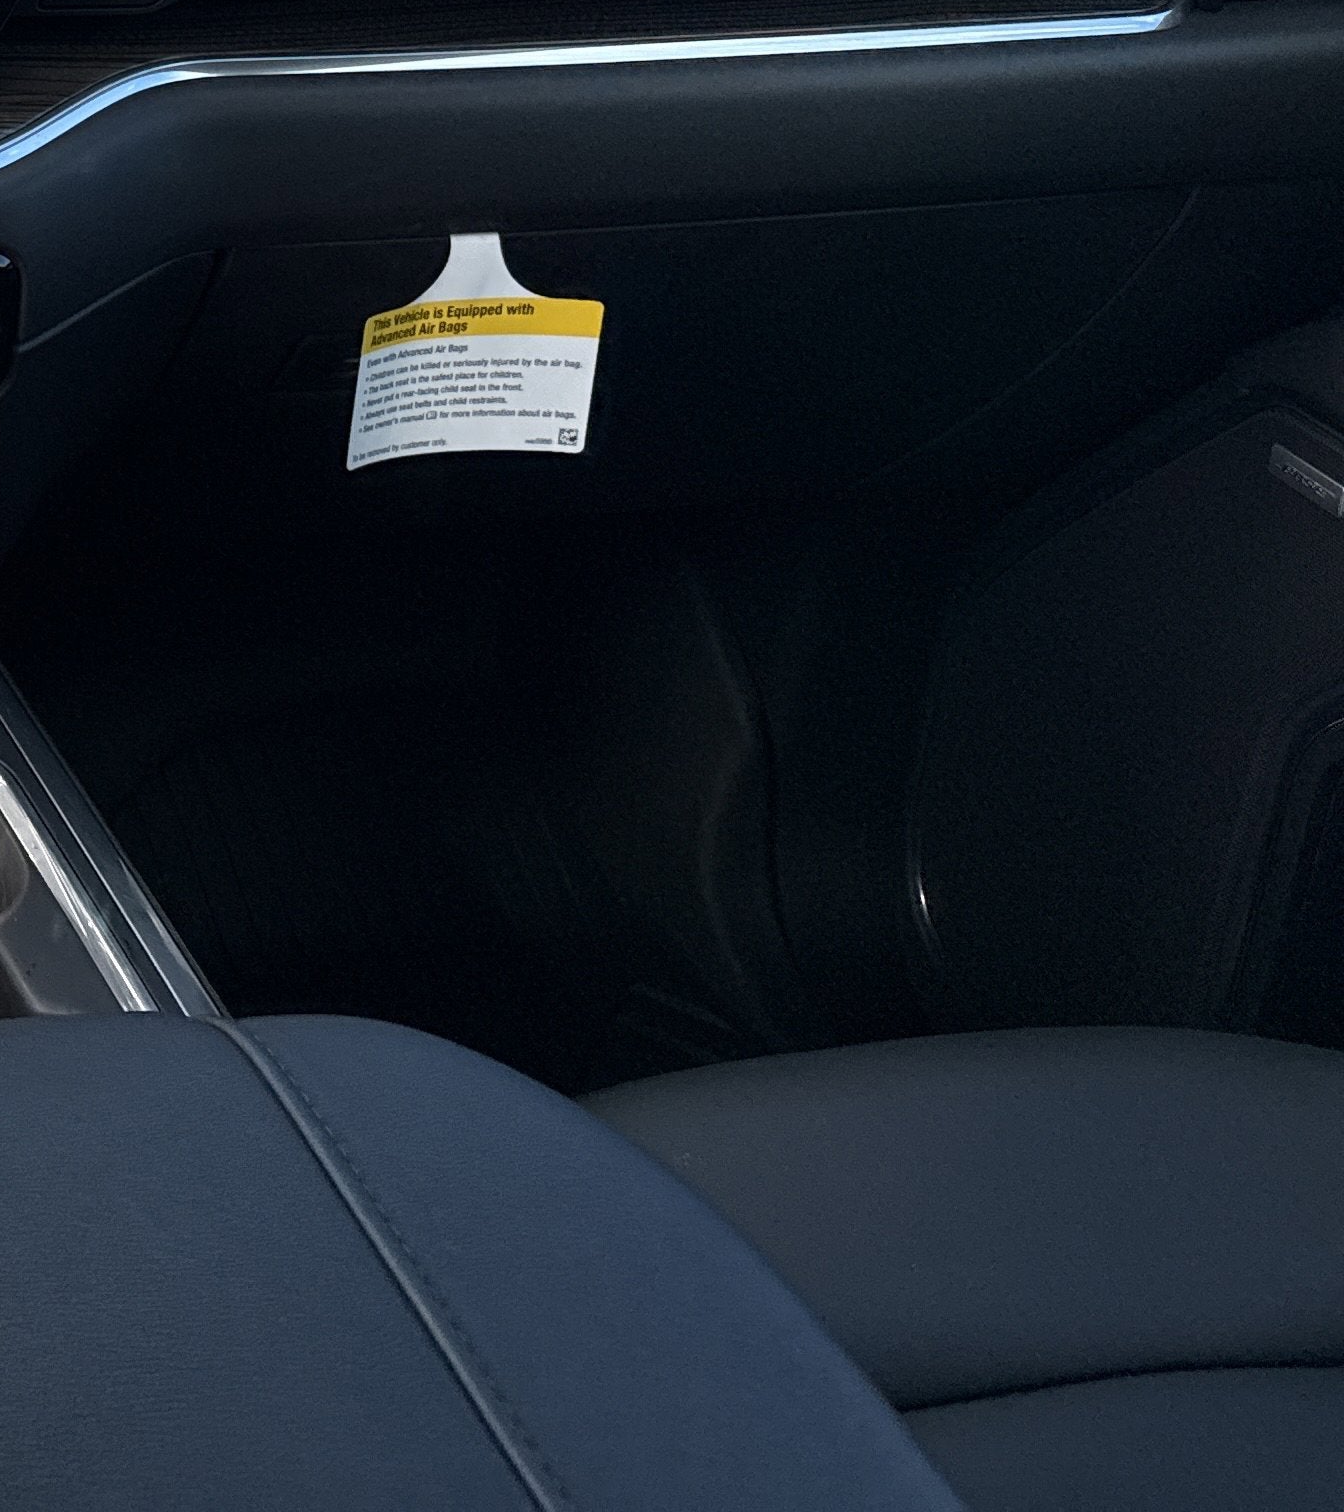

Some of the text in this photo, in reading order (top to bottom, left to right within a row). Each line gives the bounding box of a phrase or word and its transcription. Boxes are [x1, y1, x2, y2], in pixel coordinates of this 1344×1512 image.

[373, 303, 535, 331] This Vehicle is Equipped with
[370, 321, 468, 347] Advanced Air Bags
[398, 346, 433, 359] Advanced
[435, 345, 446, 353] Air
[448, 344, 468, 353] Bags
